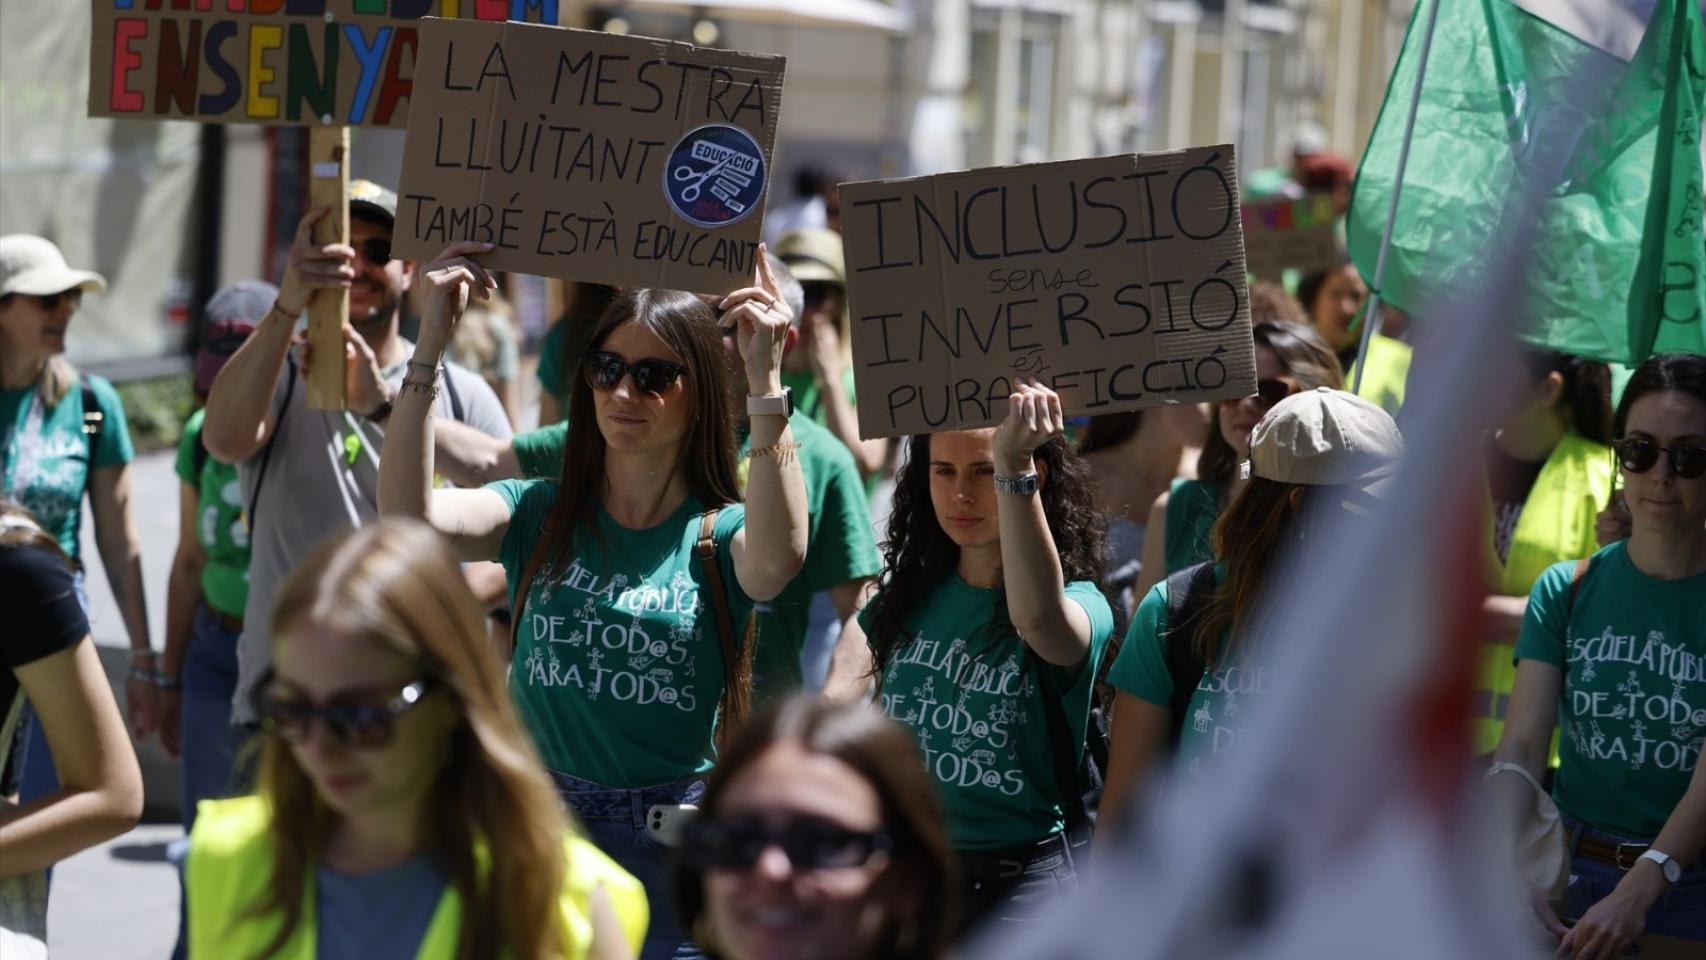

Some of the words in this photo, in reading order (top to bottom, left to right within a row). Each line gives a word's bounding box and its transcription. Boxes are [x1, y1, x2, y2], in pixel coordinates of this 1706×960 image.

[444, 41, 516, 100] LA
[550, 50, 765, 126] MESTRA
[695, 143, 754, 172] EDUCACIÓ
[405, 192, 524, 249] TAMBÉ
[536, 201, 619, 255] ESTÀ
[633, 220, 759, 276] EDUCANT
[852, 152, 1234, 272] INCLUSIÓ
[861, 260, 1239, 367] INVERSIÓ
[990, 267, 1099, 294] sense
[888, 376, 1013, 428] PURA
[1052, 344, 1228, 408] FICCIÓ
[533, 613, 573, 643] DE
[580, 619, 689, 665] TOD@S
[917, 697, 1009, 748] TOD@S
[1573, 690, 1617, 718] DE
